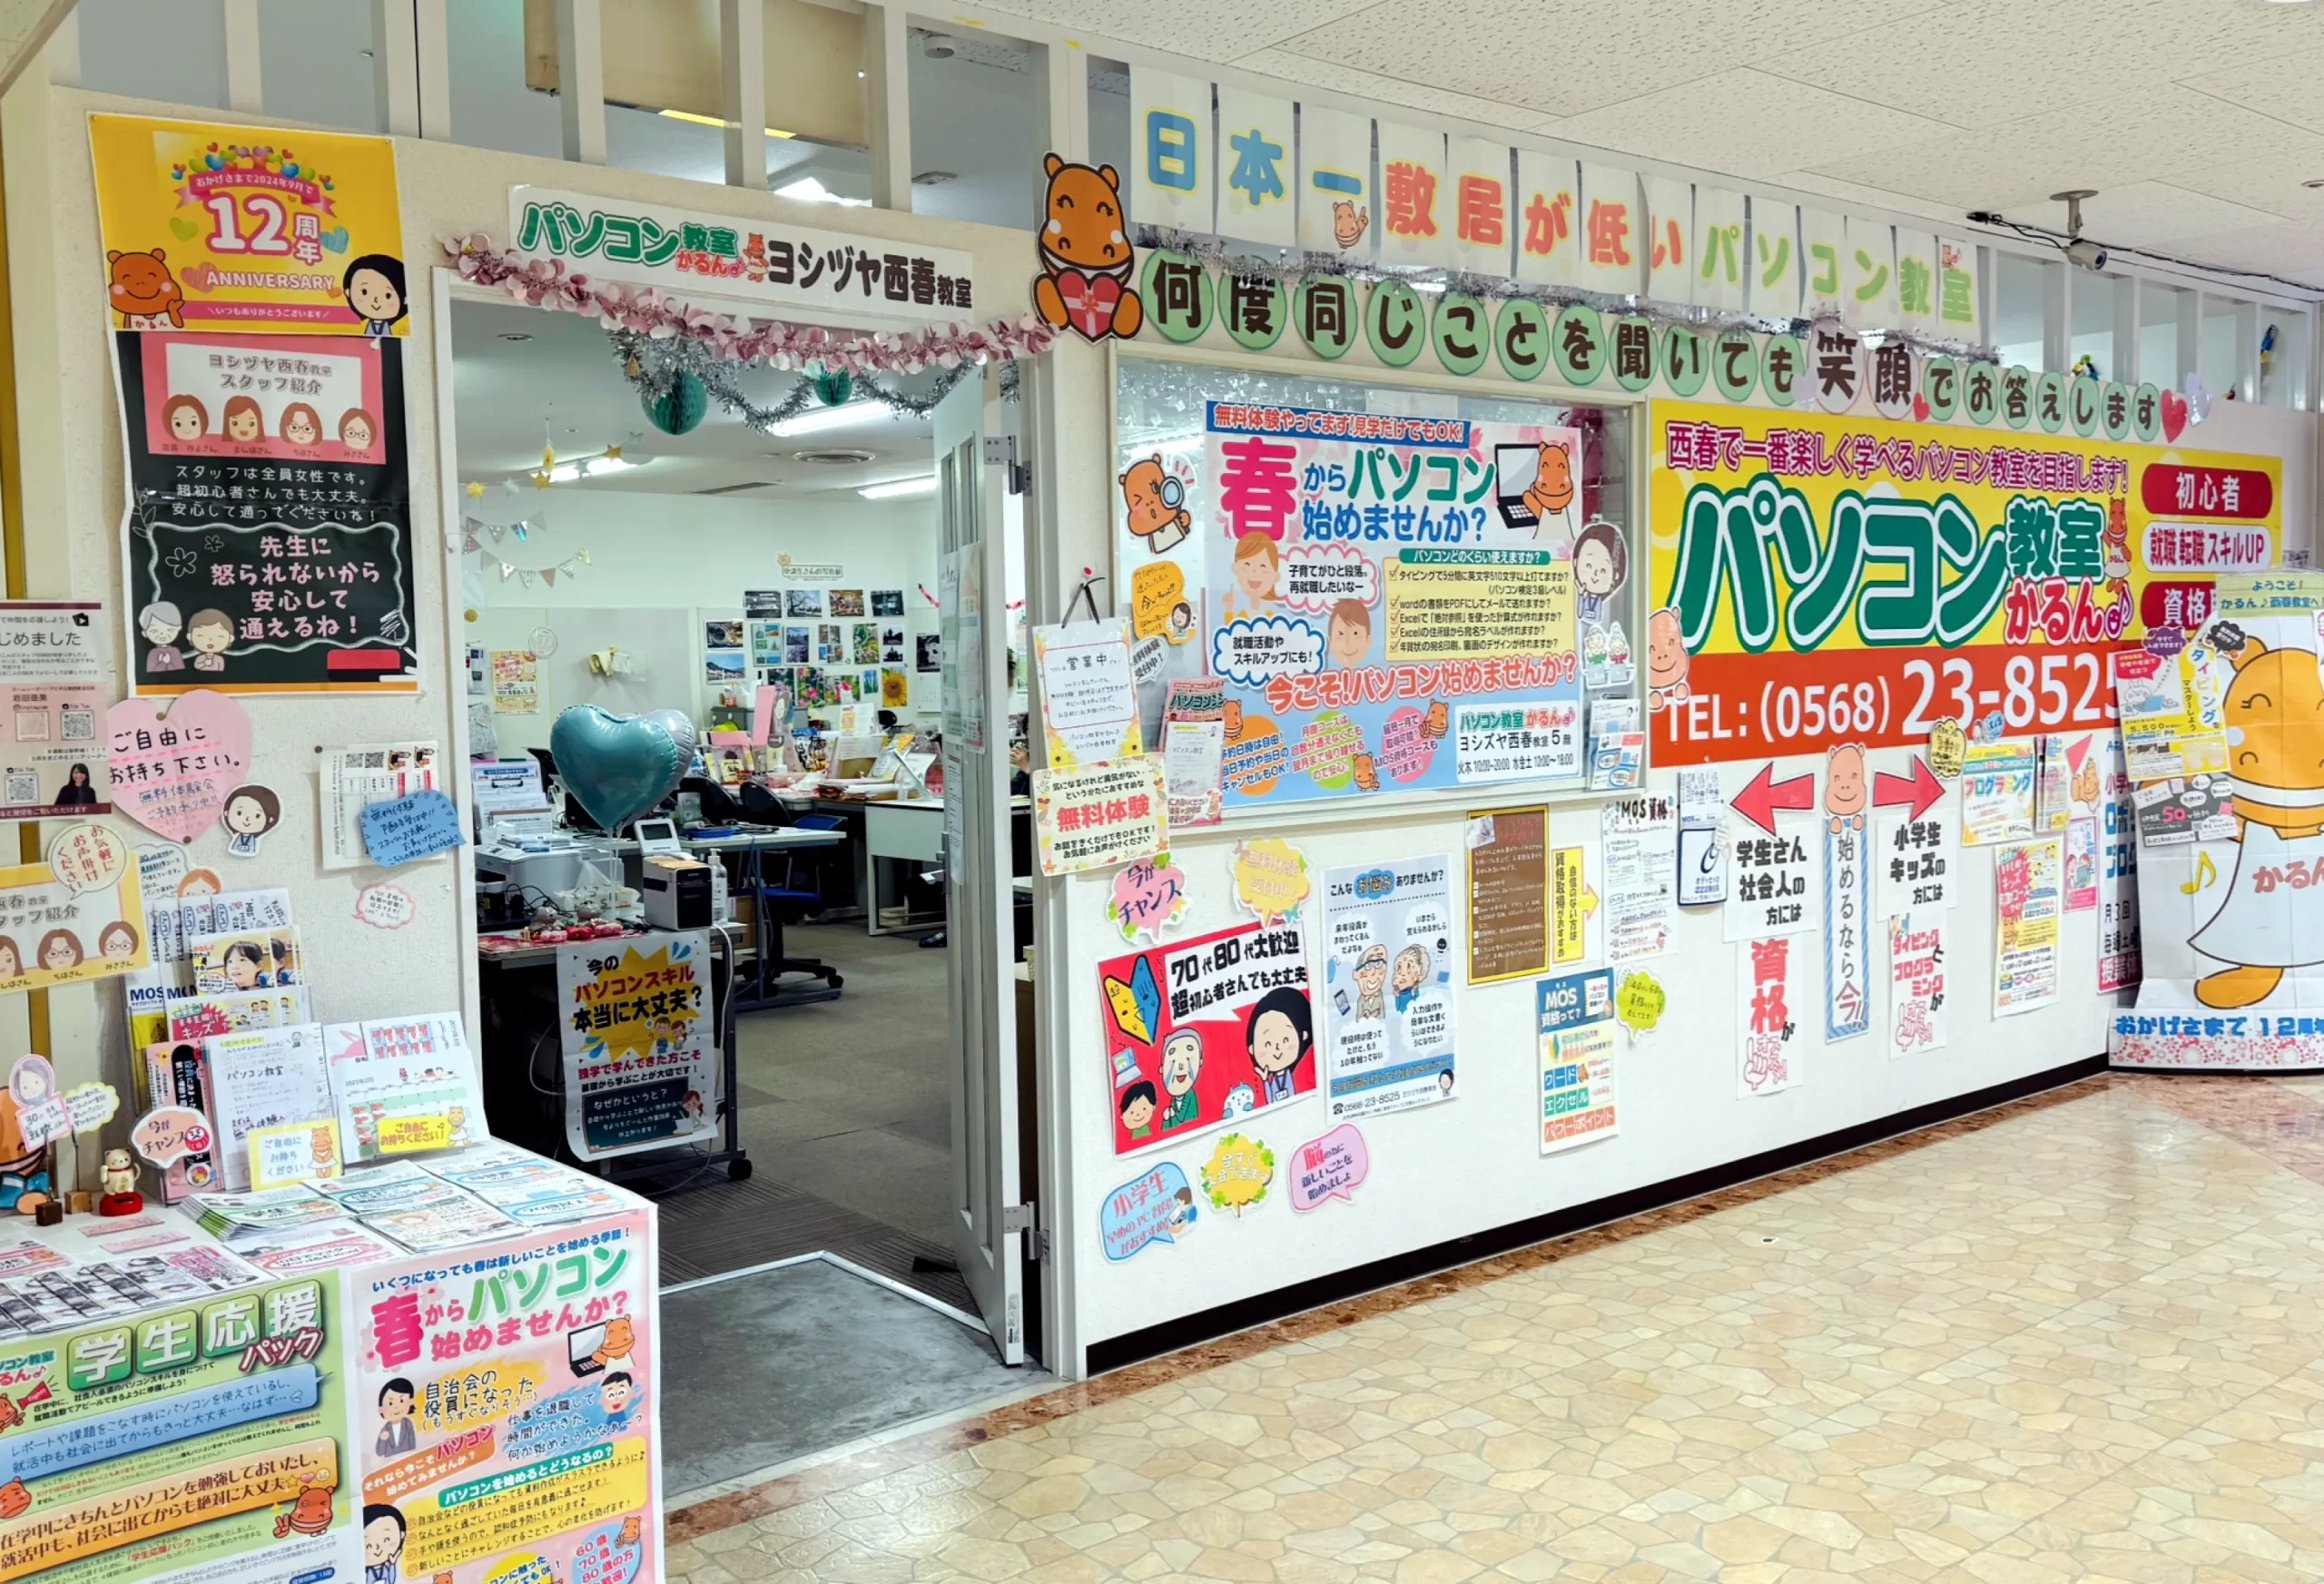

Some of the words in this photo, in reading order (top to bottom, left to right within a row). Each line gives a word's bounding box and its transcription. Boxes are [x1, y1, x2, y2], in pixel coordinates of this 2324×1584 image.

[205, 194, 290, 255] 12
[1145, 108, 1974, 323] 日本一敷居が低いパソコン教室
[293, 213, 323, 266] 周年
[518, 201, 740, 268] パソコン教室
[675, 250, 729, 275] かるん
[768, 240, 973, 310] ヨシヅヤ西春教室
[206, 271, 336, 291] ANNIVERSARY
[1152, 257, 2158, 431] 何度同じことを聞いても笑顔でお答えします
[209, 353, 332, 377] ヨシヅヤ西春教室
[221, 374, 323, 396] スタッフ紹介
[1214, 405, 1463, 443] 無料体験やってます!見学だけでもOK!
[1665, 420, 2131, 494] 西春で一番楽しく学べるパソコン教室を目指します!
[175, 465, 366, 487] スタッフは全員女性です。
[175, 484, 368, 505] 超初心者さんでも大丈夫。
[2175, 472, 2240, 513] 初心者
[1303, 502, 1487, 544] 始めませんか?
[261, 535, 331, 558] 先生に
[1413, 549, 1541, 566] パソコンどのくらい使えますか?
[211, 562, 380, 586] 怒られないから
[1288, 565, 1368, 578] 子育てがひと段落。
[1666, 471, 2106, 654] パソコン教室
[251, 589, 350, 612] 安心して
[1289, 580, 1364, 595] 再就職したいなー
[2004, 575, 2105, 646] かるん
[240, 615, 358, 641] 通えるね！
[1233, 636, 1285, 650] 就職活動や
[1459, 710, 1525, 733] パソコン教室
[1525, 708, 1561, 728] かるん
[1759, 675, 1891, 740] (0568)
[114, 727, 206, 753] ご自由に
[1964, 772, 2034, 799] プログラミング
[1056, 793, 1151, 833] 無料体験
[1620, 797, 1669, 821] MOS資格
[90, 825, 116, 873] お気軽に
[1062, 835, 1152, 861] お気軽にお声がけください
[1736, 834, 1808, 869] 学生さん
[1892, 821, 1943, 851] 小学生
[57, 846, 83, 892] ください
[1128, 863, 1155, 889] 今が
[1888, 851, 1946, 884] キッズの
[1738, 870, 1807, 902] 社会人の
[1912, 883, 1944, 906] 方には
[1118, 879, 1183, 927] チャンス
[1555, 851, 1566, 959] 資格取得がおすすめ
[1766, 903, 1803, 927] 方には
[1334, 920, 1368, 934] 来年役員が
[586, 955, 619, 976] 今の
[1170, 930, 1300, 988] 70代80代大歓迎
[575, 965, 695, 1003] パソコンスキル
[1170, 966, 1308, 1020] 超初心者さんでも大丈夫
[1544, 986, 1578, 1010] MOS
[573, 985, 703, 1033] 本当に大丈夫？
[1541, 1008, 1582, 1028] 資格って？
[227, 1065, 284, 1081] パソコン教室
[578, 1049, 702, 1080] 独学で学んできた方こそ
[1544, 1067, 1577, 1087] ワード
[593, 1088, 668, 1111] なぜかというと？
[1544, 1089, 1590, 1114] エクセル
[148, 1118, 171, 1133] 今が
[395, 1121, 428, 1134] ご自由に
[1544, 1109, 1615, 1139] パワーポイント
[143, 1130, 186, 1155] チャンス
[1303, 1140, 1345, 1172] 脳のために
[1222, 1151, 1258, 1168] 今すぐ
[1301, 1153, 1354, 1189] 新しいことを
[1113, 1170, 1170, 1218] 小学生
[372, 1226, 631, 1293] いくつになっても春は新しいことを始める季節！
[71, 1285, 320, 1385] 学生応援
[238, 1326, 324, 1373] パック
[424, 1376, 534, 1418] 役員になった
[425, 1370, 497, 1401] 自治会の
[11, 1379, 291, 1456] レポートや課題をこなす時にパソコンを使えているし、
[507, 1392, 596, 1427] 仕事を退職して
[507, 1416, 590, 1444] 時間ができた。
[386, 1451, 477, 1497] 始めてみませんか？
[444, 1445, 613, 1506] パソコンを始めるとどうなるの？
